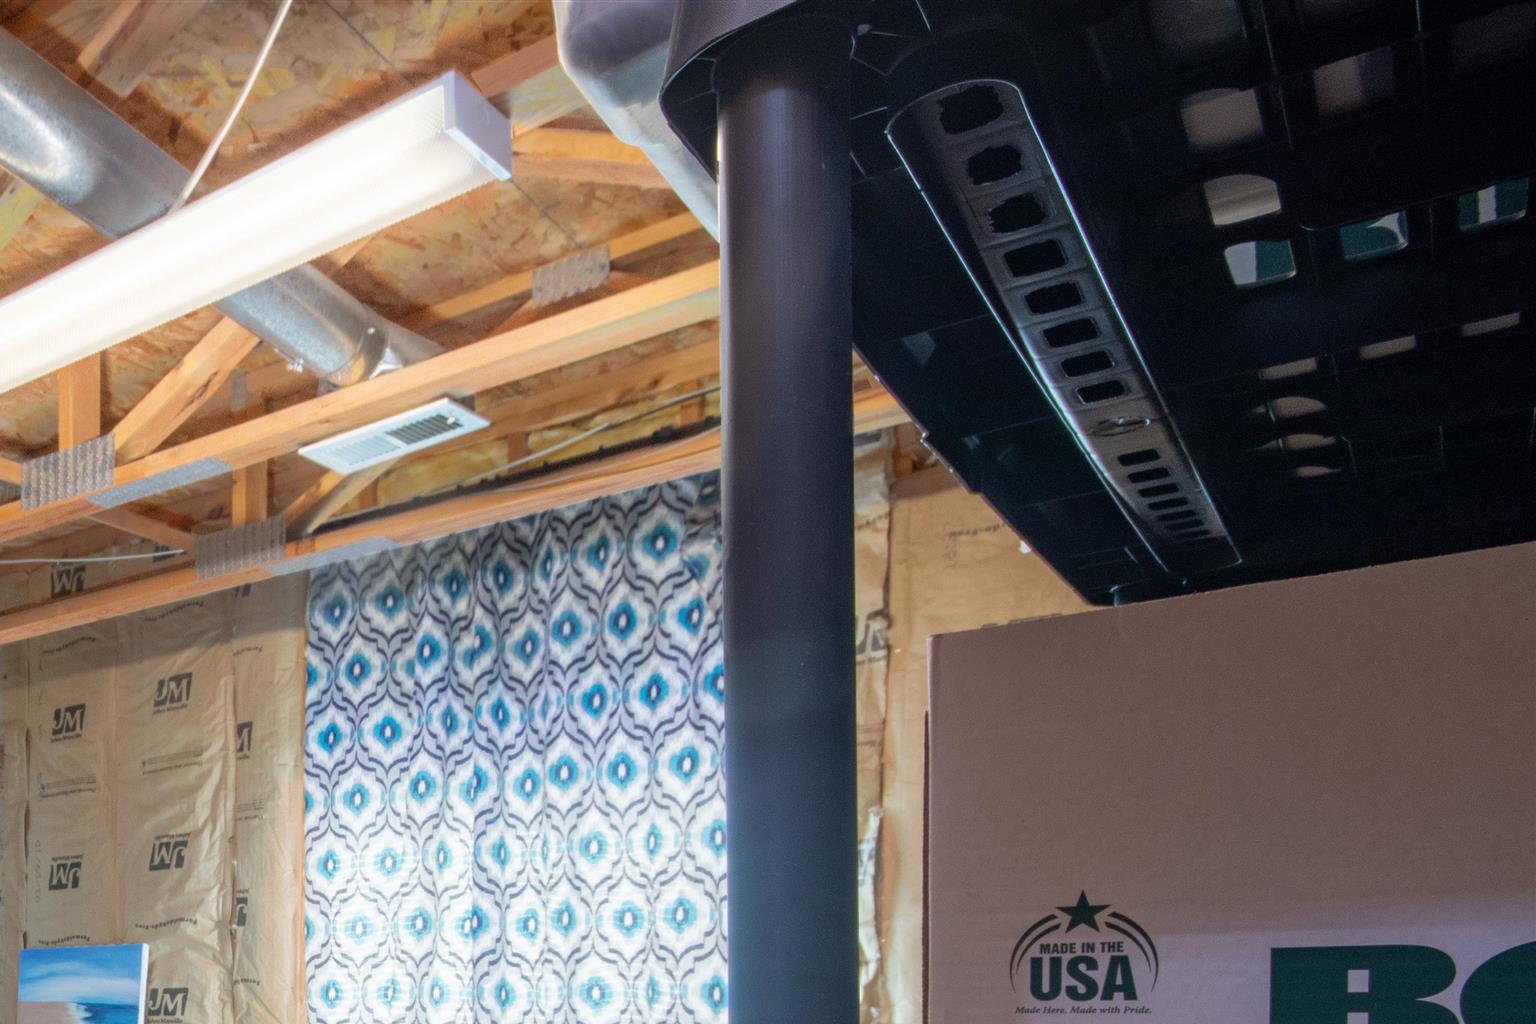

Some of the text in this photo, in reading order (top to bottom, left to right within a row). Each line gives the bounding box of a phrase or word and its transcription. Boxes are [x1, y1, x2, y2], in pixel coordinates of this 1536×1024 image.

[152, 672, 193, 708] JM
[51, 703, 86, 736] JM
[149, 839, 189, 872] JM
[49, 861, 83, 891] JM
[1039, 940, 1125, 955] MADE IN THE
[1029, 954, 1138, 1002] USA
[146, 986, 189, 1017] JM
[1015, 1005, 1153, 1016] Made Here. Made with Pride.
